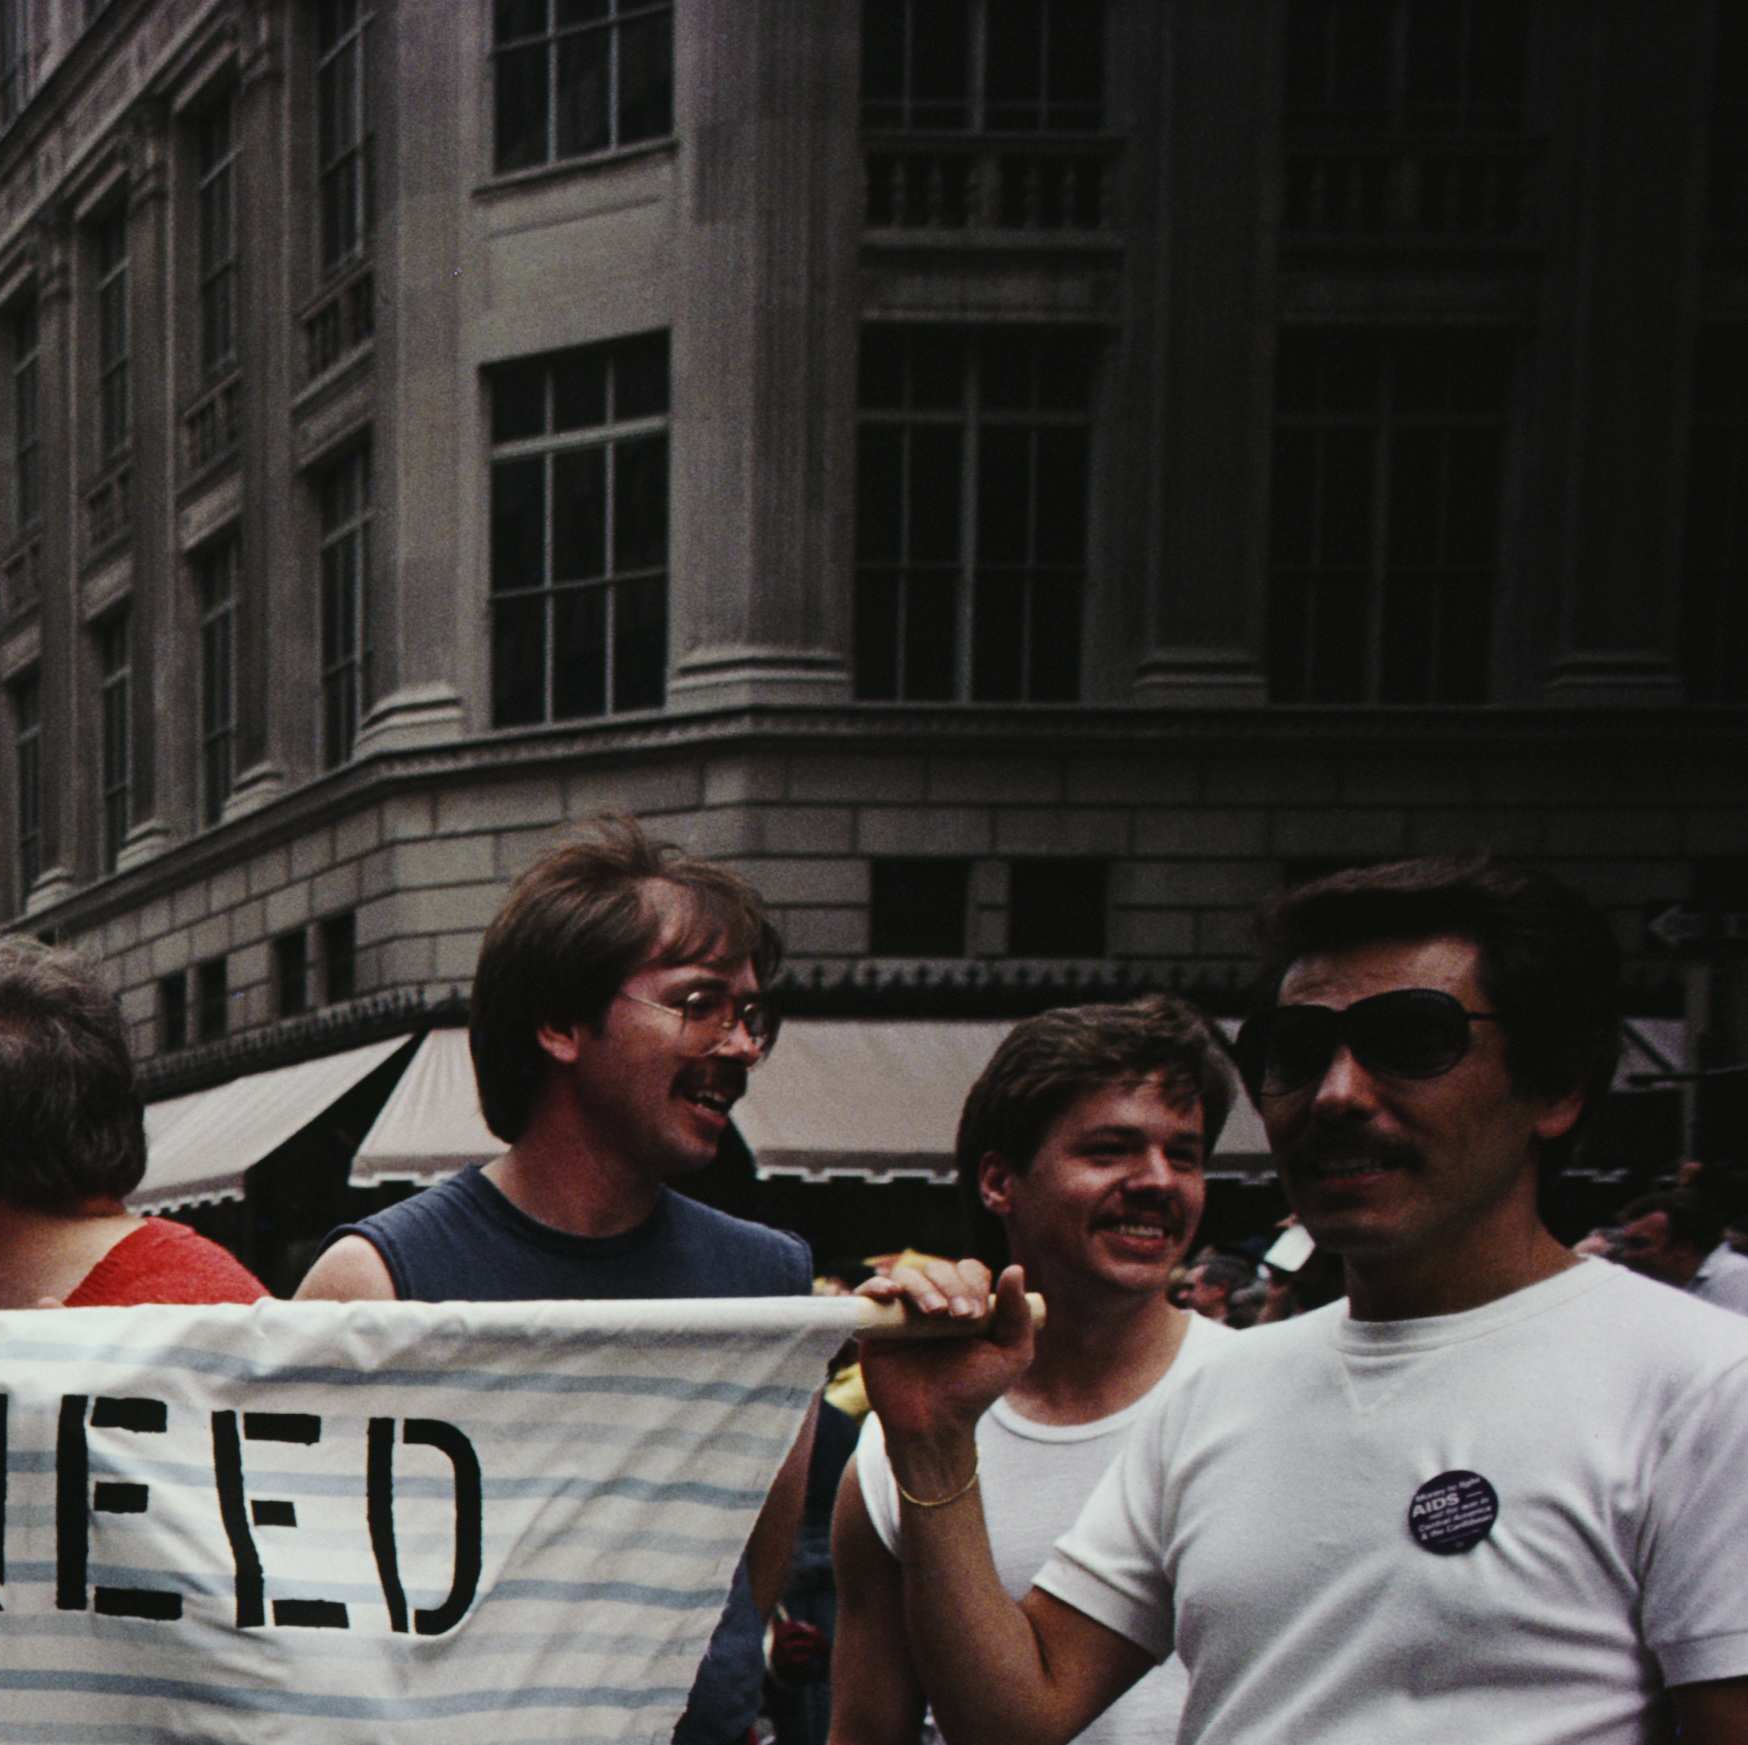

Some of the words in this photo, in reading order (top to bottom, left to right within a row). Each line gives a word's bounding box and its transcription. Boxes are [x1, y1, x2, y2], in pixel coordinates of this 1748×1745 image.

[1412, 1492, 1460, 1518] AIDS
[1418, 1516, 1451, 1533] Central
[1453, 1505, 1492, 1521] America
[1446, 1514, 1494, 1533] Caribbean
